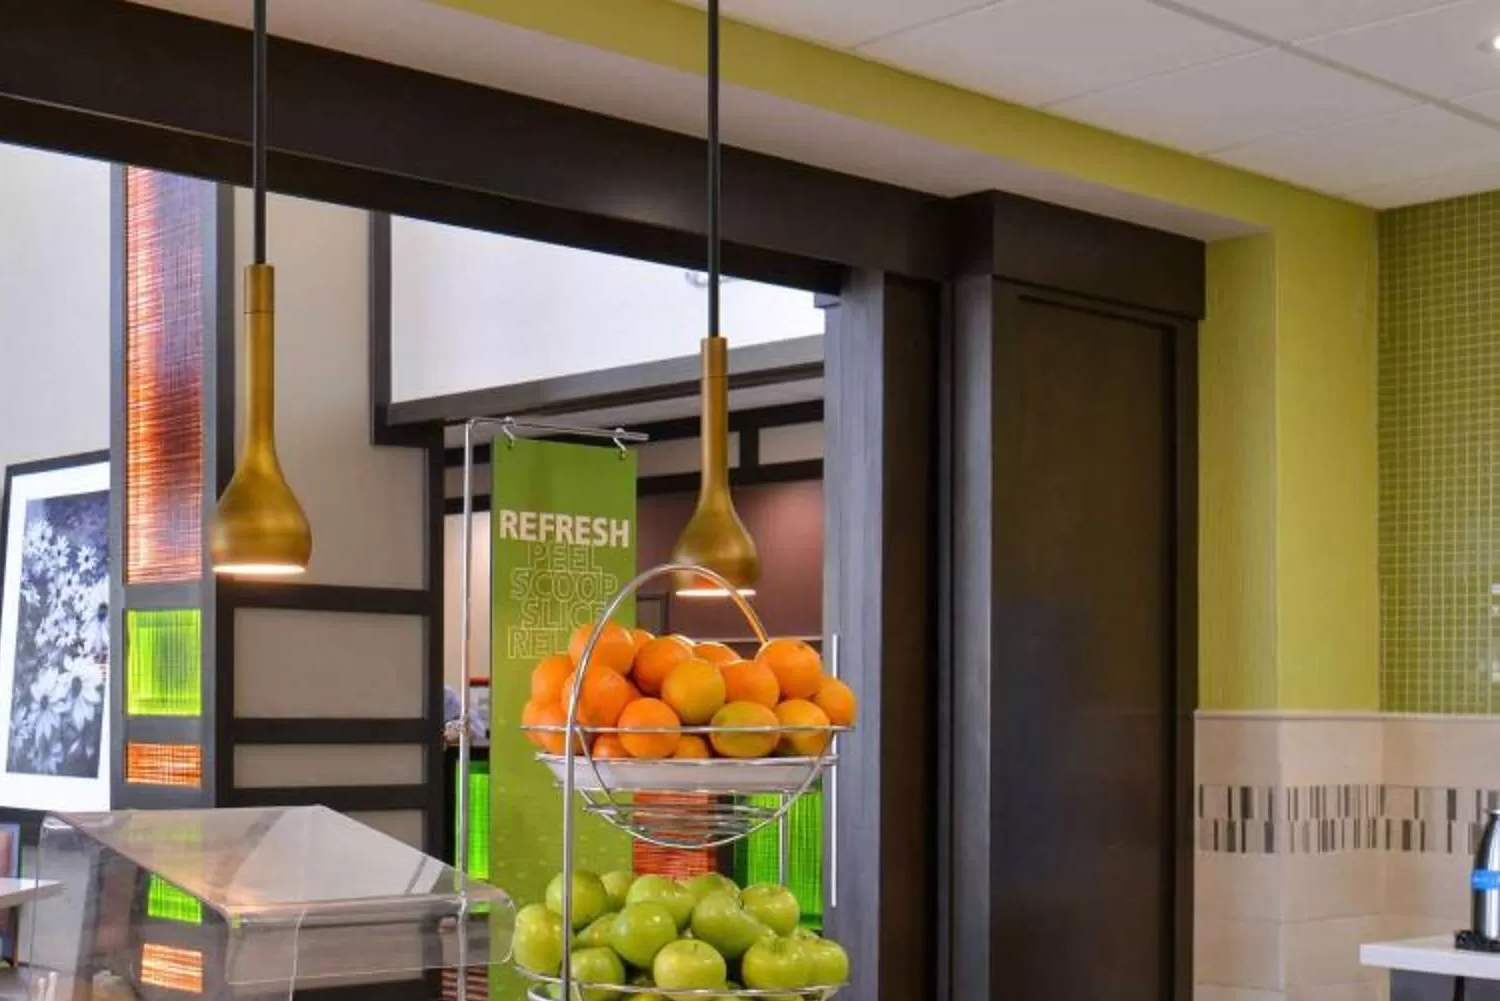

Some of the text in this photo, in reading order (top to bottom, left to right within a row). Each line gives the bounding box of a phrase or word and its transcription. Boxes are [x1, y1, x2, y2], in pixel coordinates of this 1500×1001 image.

[499, 509, 629, 547] REFRESH
[528, 541, 603, 573] PEEL
[510, 568, 619, 603] SCOOP
